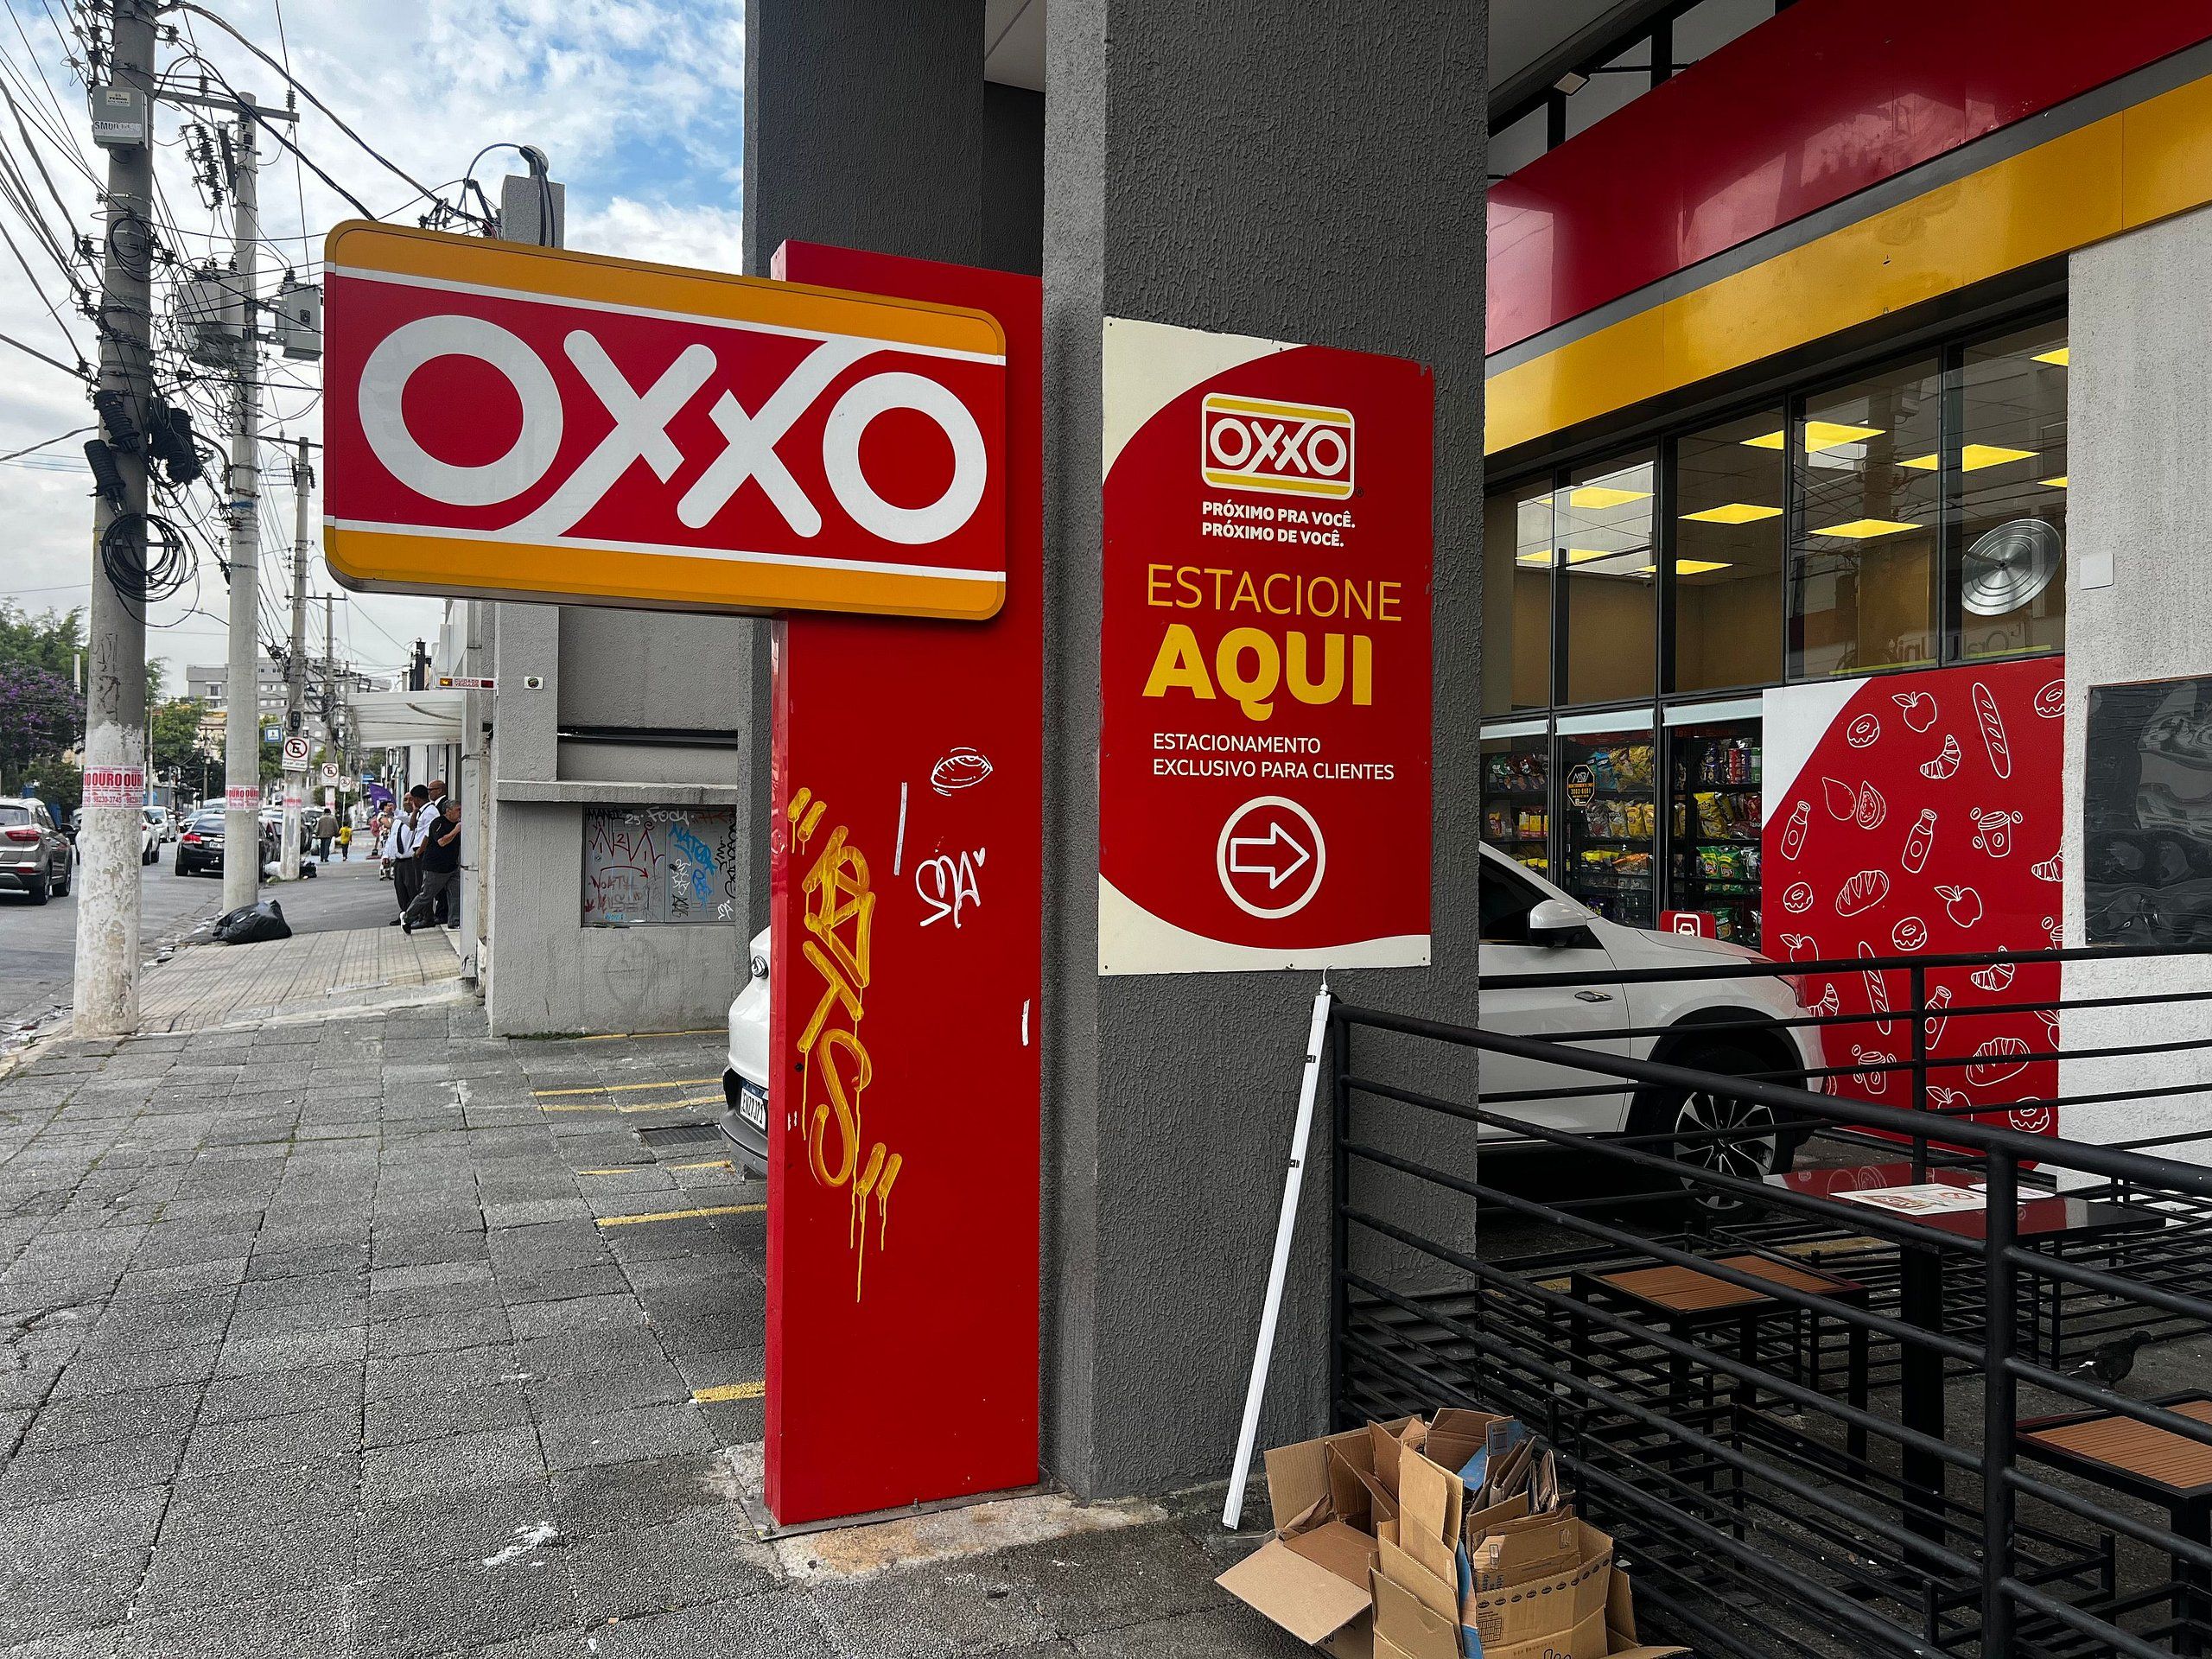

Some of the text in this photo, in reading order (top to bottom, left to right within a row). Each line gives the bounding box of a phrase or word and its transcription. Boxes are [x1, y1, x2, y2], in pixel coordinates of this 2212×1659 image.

[358, 314, 988, 545] OXXO
[1210, 417, 1347, 476] OXXO
[1202, 499, 1356, 528] PRÓXIMO PRA VOCÊ.
[1202, 520, 1344, 547] PRÓXIMO DE VOCÊ.
[1147, 563, 1402, 622] ESTACIONE
[1142, 624, 1373, 721] AQUI
[1153, 732, 1321, 754] ESTACIONAMENTO
[92, 773, 122, 786] OURO
[1153, 758, 1395, 781] EXCLUSIVO PARA CLIENTES
